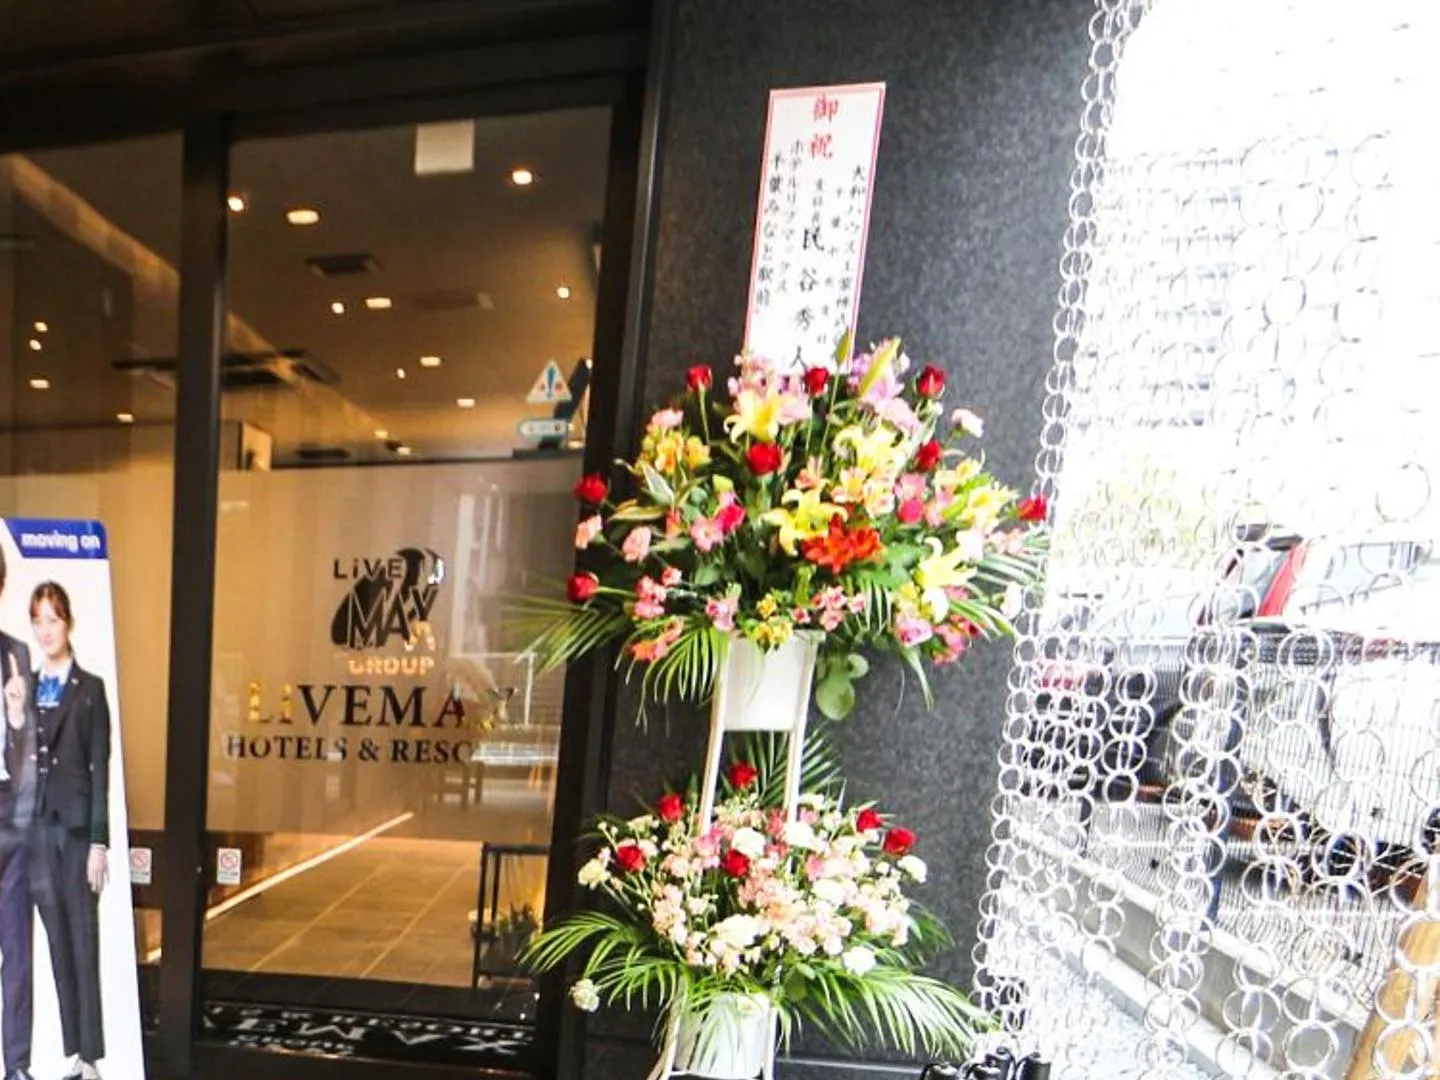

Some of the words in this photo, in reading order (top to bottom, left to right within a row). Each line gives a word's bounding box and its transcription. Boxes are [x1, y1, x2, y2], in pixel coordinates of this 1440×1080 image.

[807, 92, 839, 161] 御祝
[21, 530, 79, 552] moving
[81, 533, 101, 550] on
[347, 655, 436, 677] GROUP
[227, 734, 348, 763] HOTELS
[358, 737, 380, 762] &
